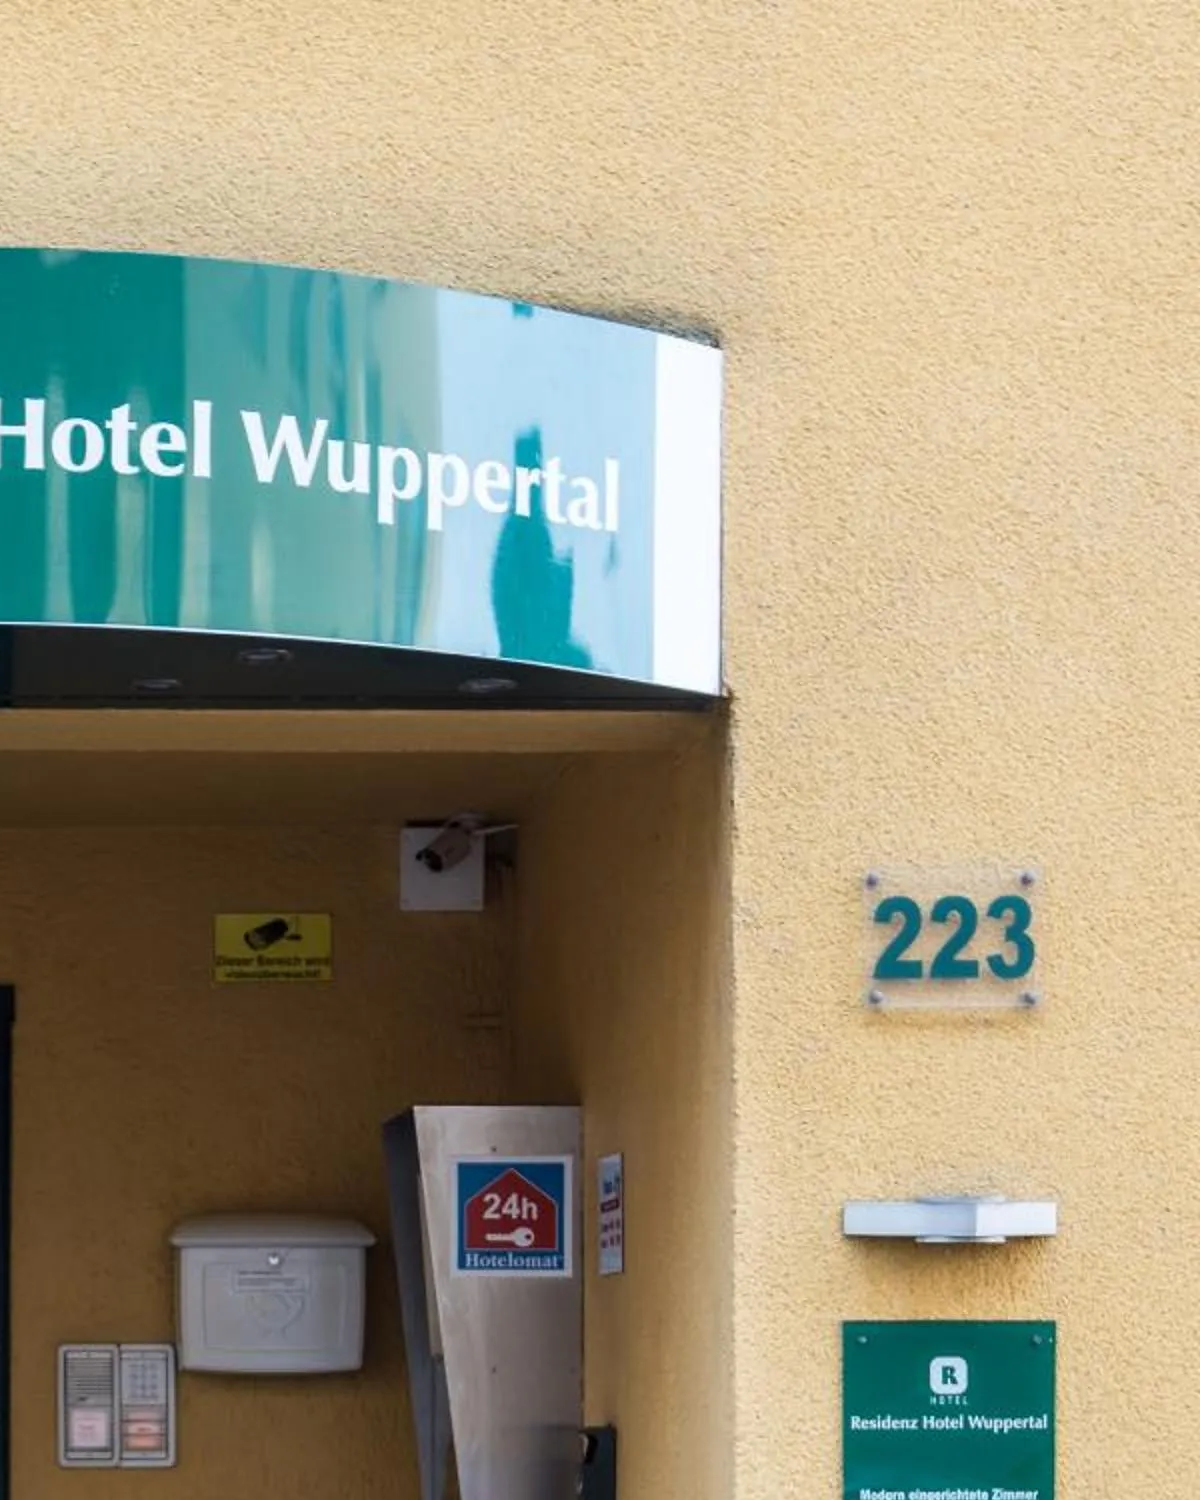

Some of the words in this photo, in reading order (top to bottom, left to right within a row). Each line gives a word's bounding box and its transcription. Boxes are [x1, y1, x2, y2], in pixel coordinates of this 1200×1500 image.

[240, 409, 621, 532] Wuppertal
[872, 895, 1035, 981] 223
[482, 1192, 539, 1220] 24h
[465, 1251, 558, 1267] Hotelomat
[941, 1366, 958, 1385] R
[930, 1395, 968, 1405] HOTEL
[850, 1414, 918, 1430] Residenz
[923, 1414, 964, 1430] Hotel
[968, 1414, 1048, 1433] Wuppertal
[859, 1488, 905, 1500] Modern
[991, 1488, 1038, 1500] Zimmer
